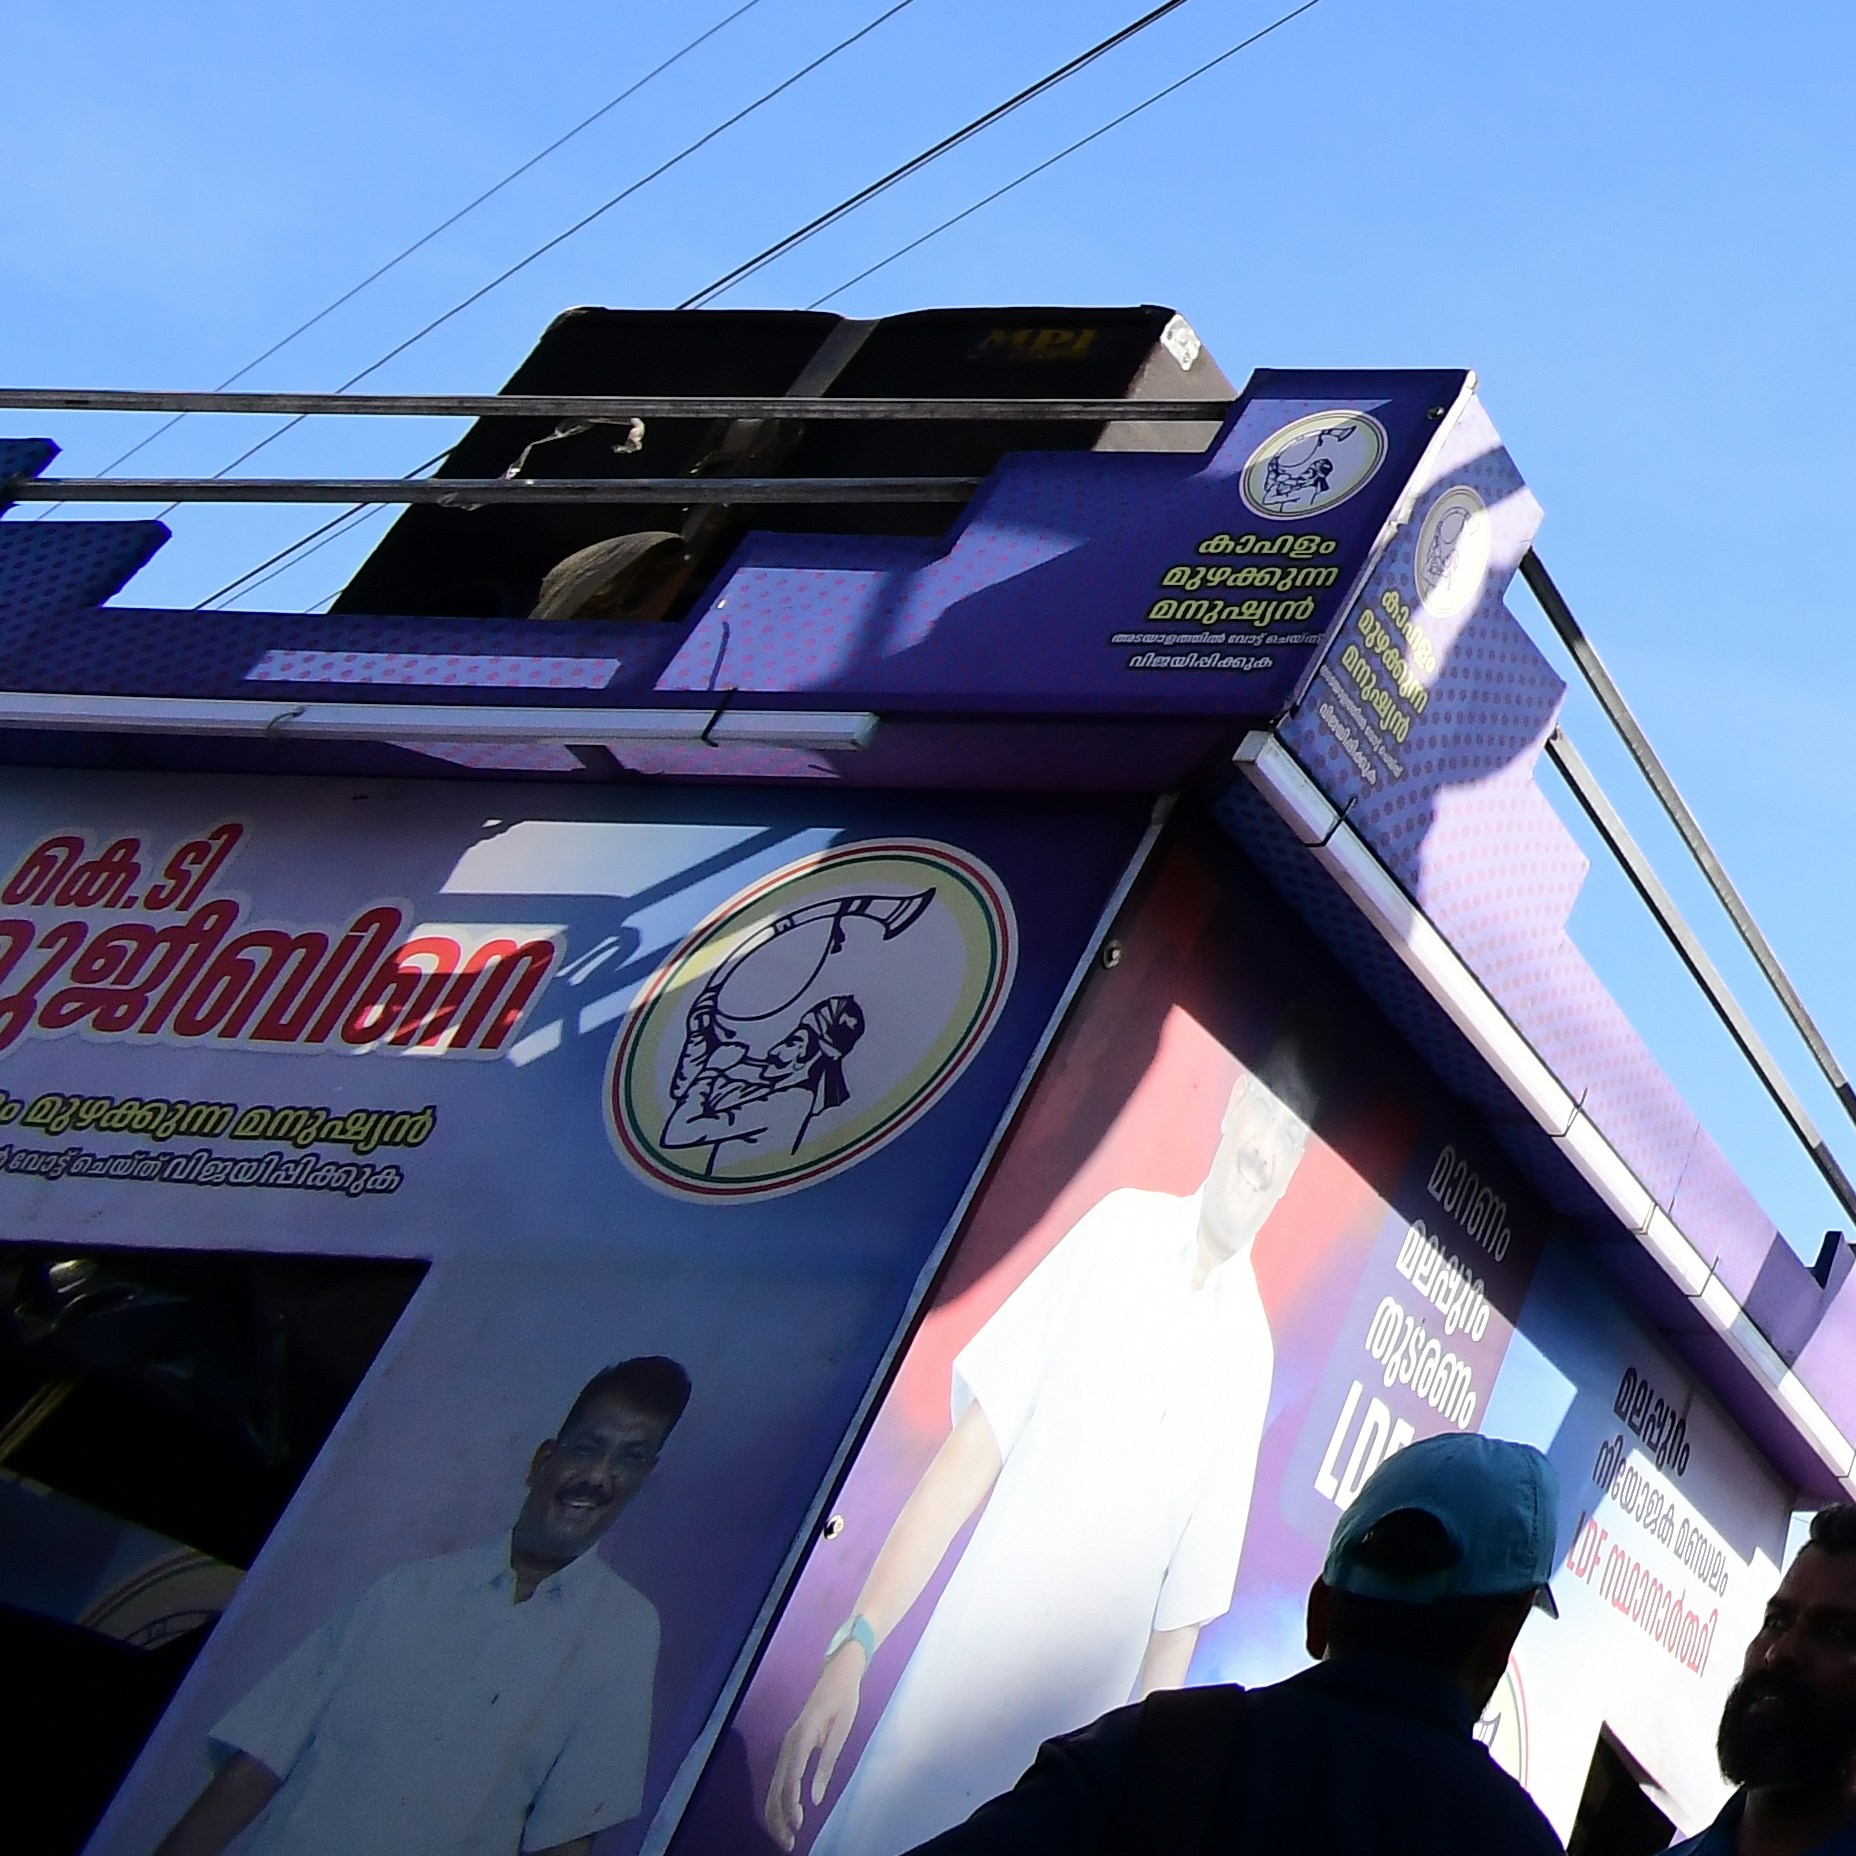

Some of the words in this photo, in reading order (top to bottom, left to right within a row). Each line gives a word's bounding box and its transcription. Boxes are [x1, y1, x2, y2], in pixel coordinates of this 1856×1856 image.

[1161, 566, 1339, 591] മുഴക്കുന്ന
[1198, 534, 1337, 558] കാഹളം
[1148, 596, 1315, 626] മനുഷ്യൻ
[1381, 590, 1436, 673] കാഹളം
[1128, 652, 1273, 671] വിജയിപ്പിക്കുക
[1341, 645, 1411, 743] മനുഷ്യൻ
[1358, 608, 1429, 714] മുഴക്കുന്ന
[25, 1094, 234, 1139] മുഴക്കുന്ന
[233, 1105, 436, 1150] മനുഷ്യൻ
[163, 1150, 401, 1195] വിജയിപ്പിക്കുക
[1426, 1144, 1512, 1262] മാറണം
[1395, 1219, 1491, 1342] മലപ്പുറം
[1364, 1296, 1477, 1429] തുടരണം
[1612, 1366, 1691, 1477] മലപ്പുറം
[1591, 1434, 1675, 1548] നിയോജക
[1566, 1510, 1609, 1586] LDF
